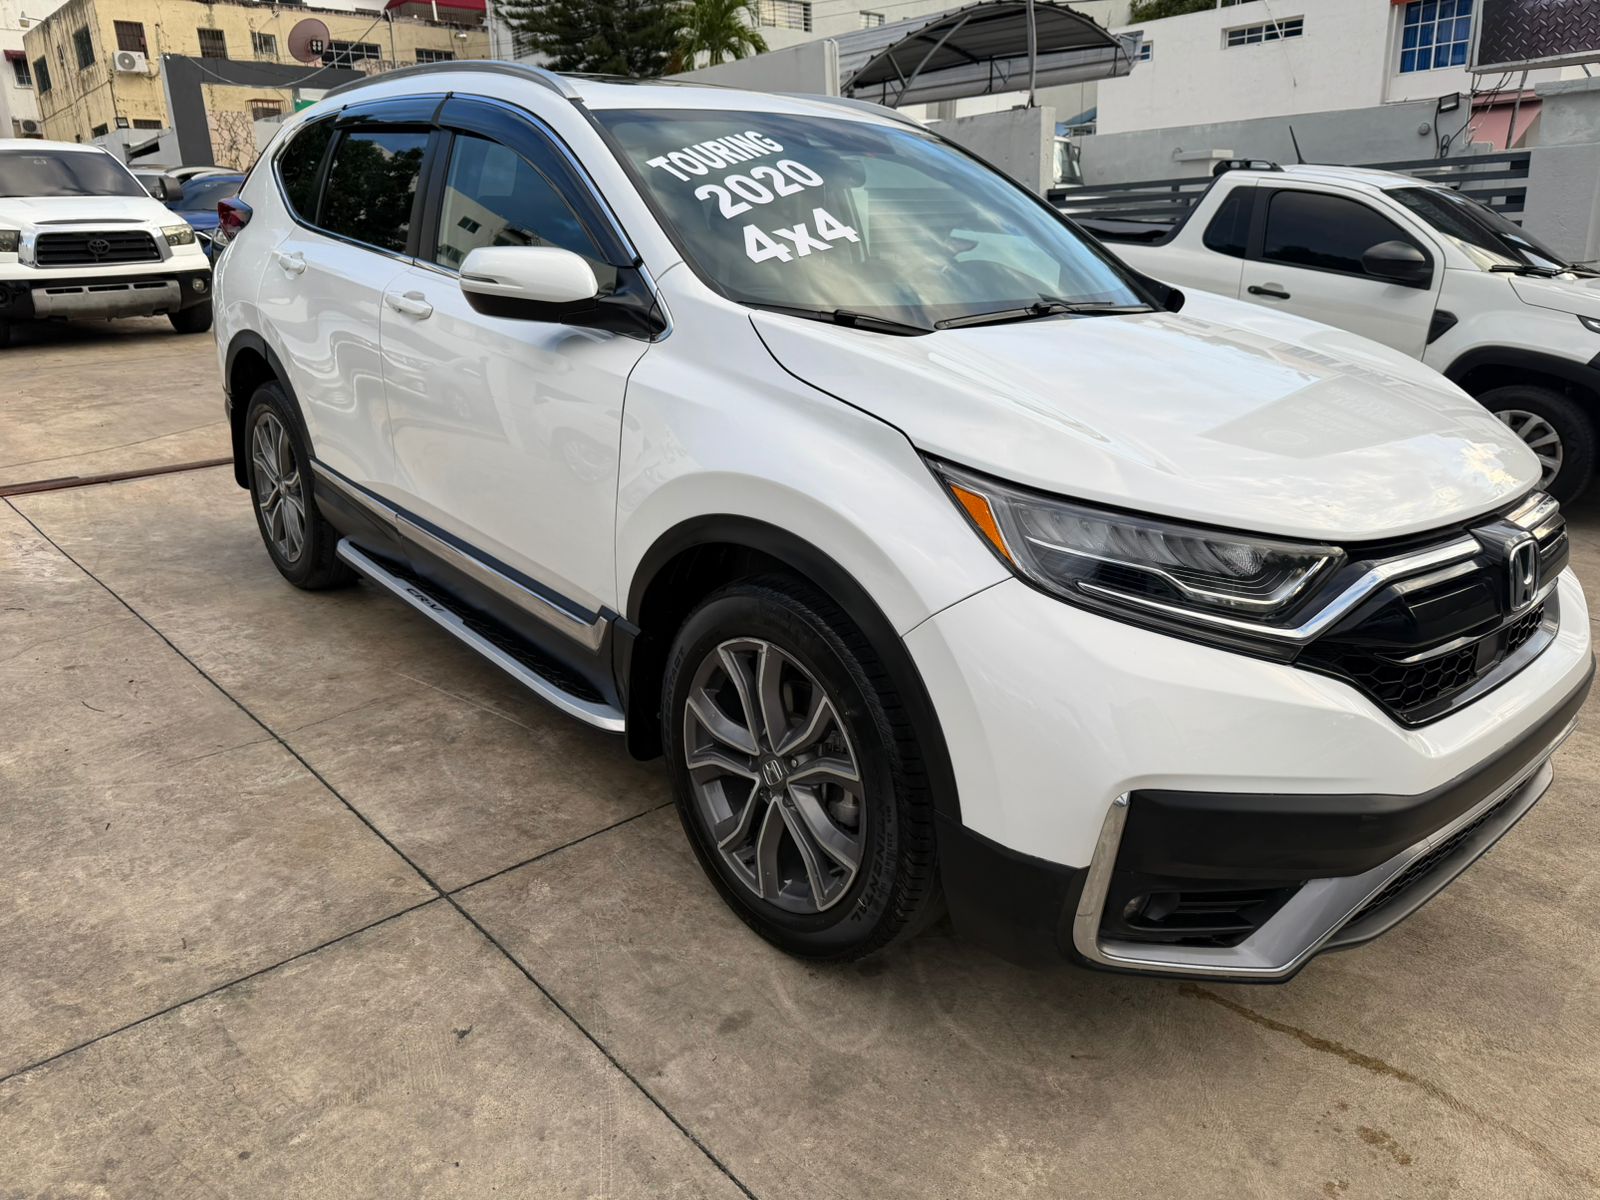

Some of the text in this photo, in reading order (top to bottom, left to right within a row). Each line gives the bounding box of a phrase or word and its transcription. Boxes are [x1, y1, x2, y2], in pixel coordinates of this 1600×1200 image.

[645, 130, 784, 182] TOURING
[694, 159, 824, 219] 2020
[743, 207, 861, 263] 4x4
[406, 588, 445, 612] CR-V
